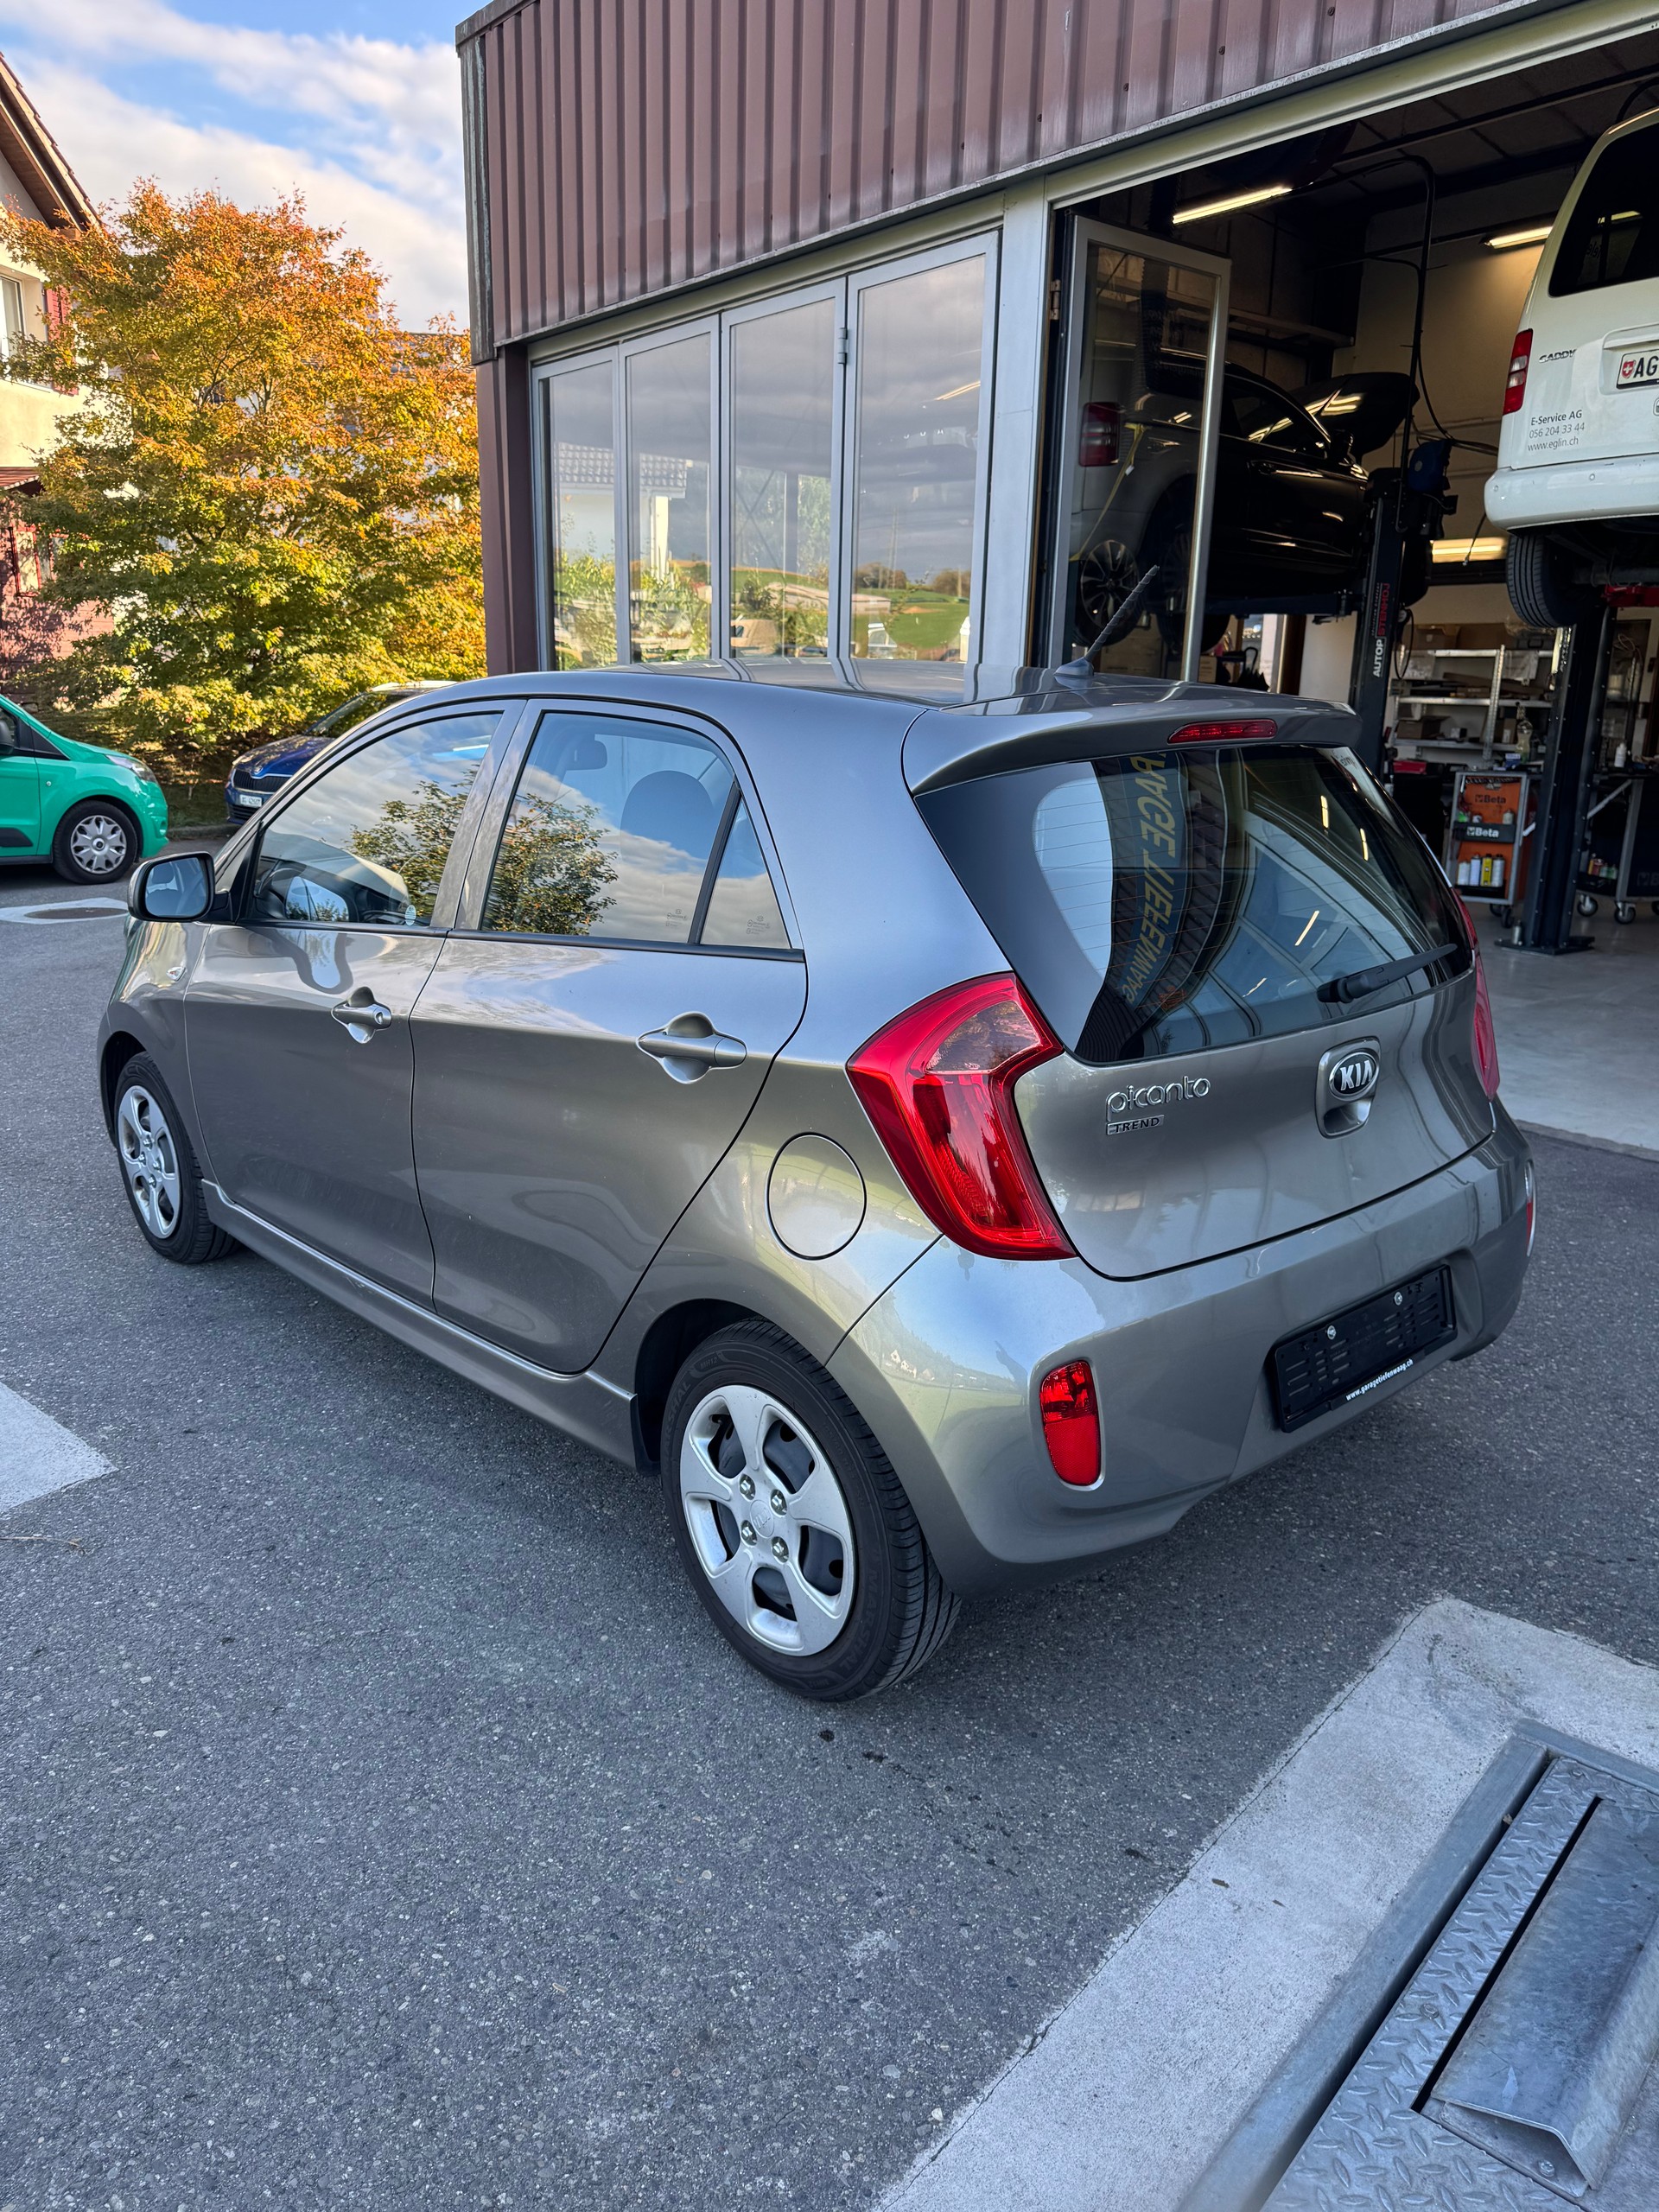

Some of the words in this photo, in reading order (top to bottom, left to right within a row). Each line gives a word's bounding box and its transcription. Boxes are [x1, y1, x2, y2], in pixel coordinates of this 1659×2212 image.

[1538, 349, 1577, 364] CADDY
[1633, 355, 1658, 378] AG
[1530, 413, 1567, 426] E-Service
[1568, 410, 1583, 420] AG
[1529, 429, 1543, 439] 056
[1545, 426, 1560, 436] 204
[1561, 424, 1572, 434] 33
[1573, 423, 1586, 432] 44
[1527, 436, 1580, 452] www.eglin.ch
[1373, 639, 1383, 677] AUTOP
[1484, 794, 1506, 804] Beta
[1475, 827, 1499, 838] Beta
[1339, 1058, 1374, 1091] KIA
[1106, 1076, 1211, 1121] picanto
[1114, 1116, 1160, 1134] TREND
[1345, 1357, 1414, 1402] www.garagetiefenwaag.ch
